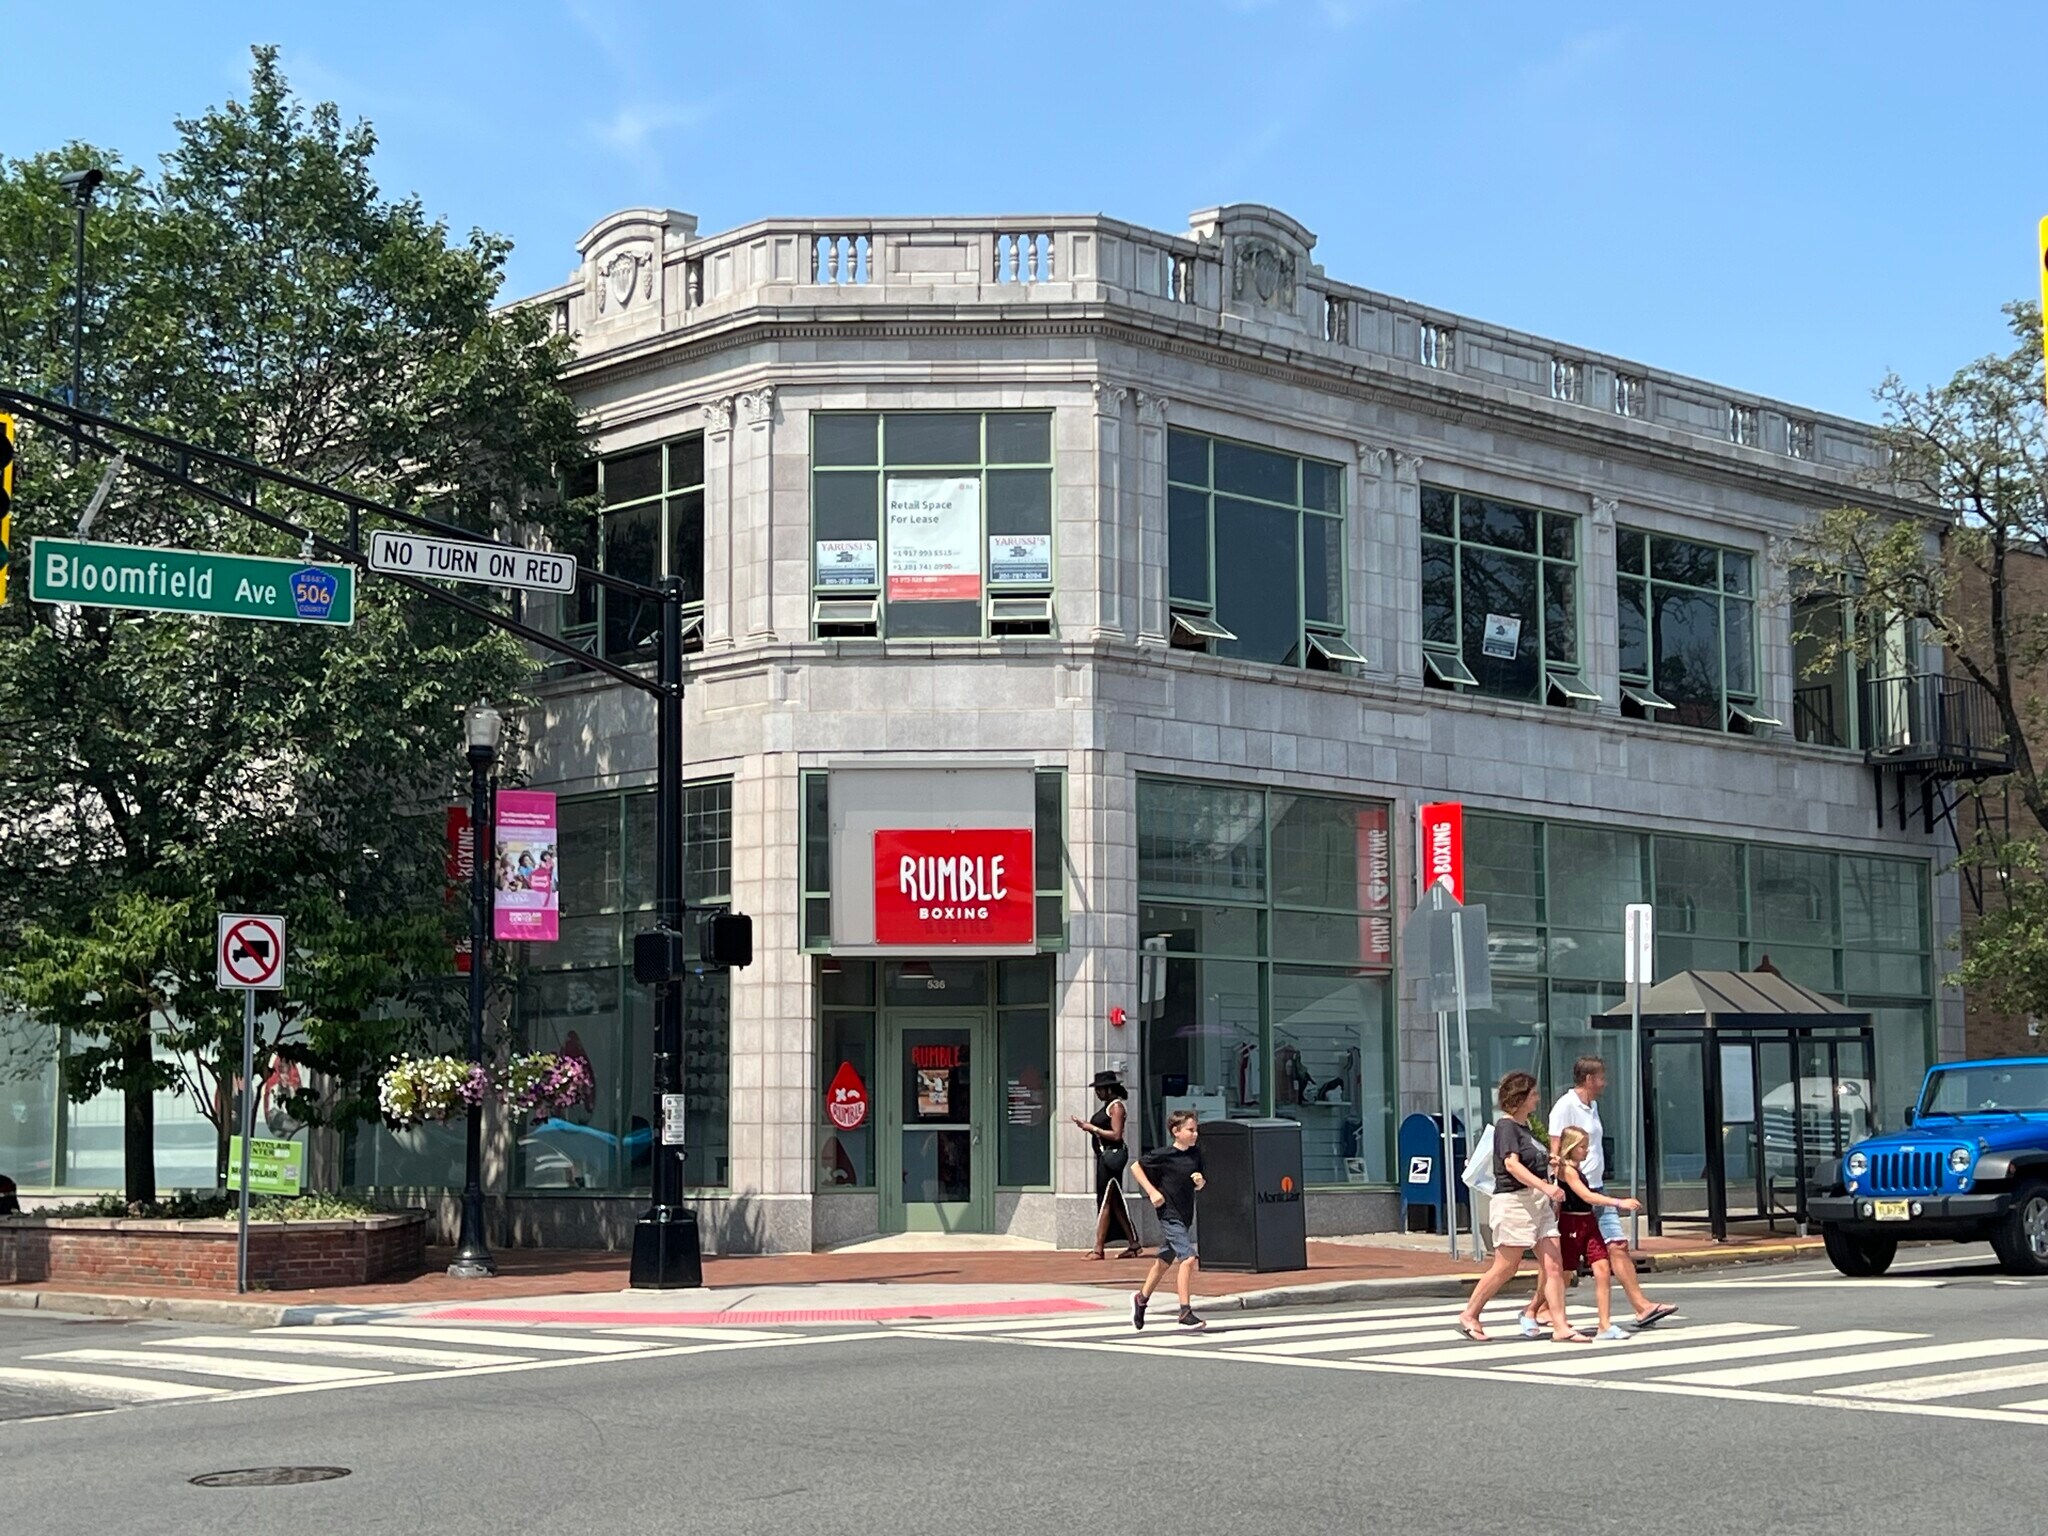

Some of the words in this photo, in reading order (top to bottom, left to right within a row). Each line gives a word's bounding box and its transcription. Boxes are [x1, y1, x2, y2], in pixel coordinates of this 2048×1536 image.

[891, 500, 920, 510] Retail
[922, 500, 953, 511] Space
[890, 514, 908, 524] For
[910, 514, 940, 524] Lease
[821, 542, 873, 551] YARUSSI'S
[994, 536, 1047, 546] YARUSSI'S
[383, 540, 413, 566] NO
[426, 543, 478, 574] TURN
[489, 551, 517, 578] ON
[526, 554, 564, 584] RED
[46, 552, 213, 601] Bloomfield
[235, 578, 277, 606] Ave
[296, 583, 331, 605] 506
[299, 604, 328, 613] COUNTY
[1433, 821, 1452, 875] BOXING
[899, 853, 1008, 903] RUMBLE
[918, 906, 990, 921] BOXING
[927, 979, 946, 989] 536
[911, 1045, 961, 1068] RUMBLE
